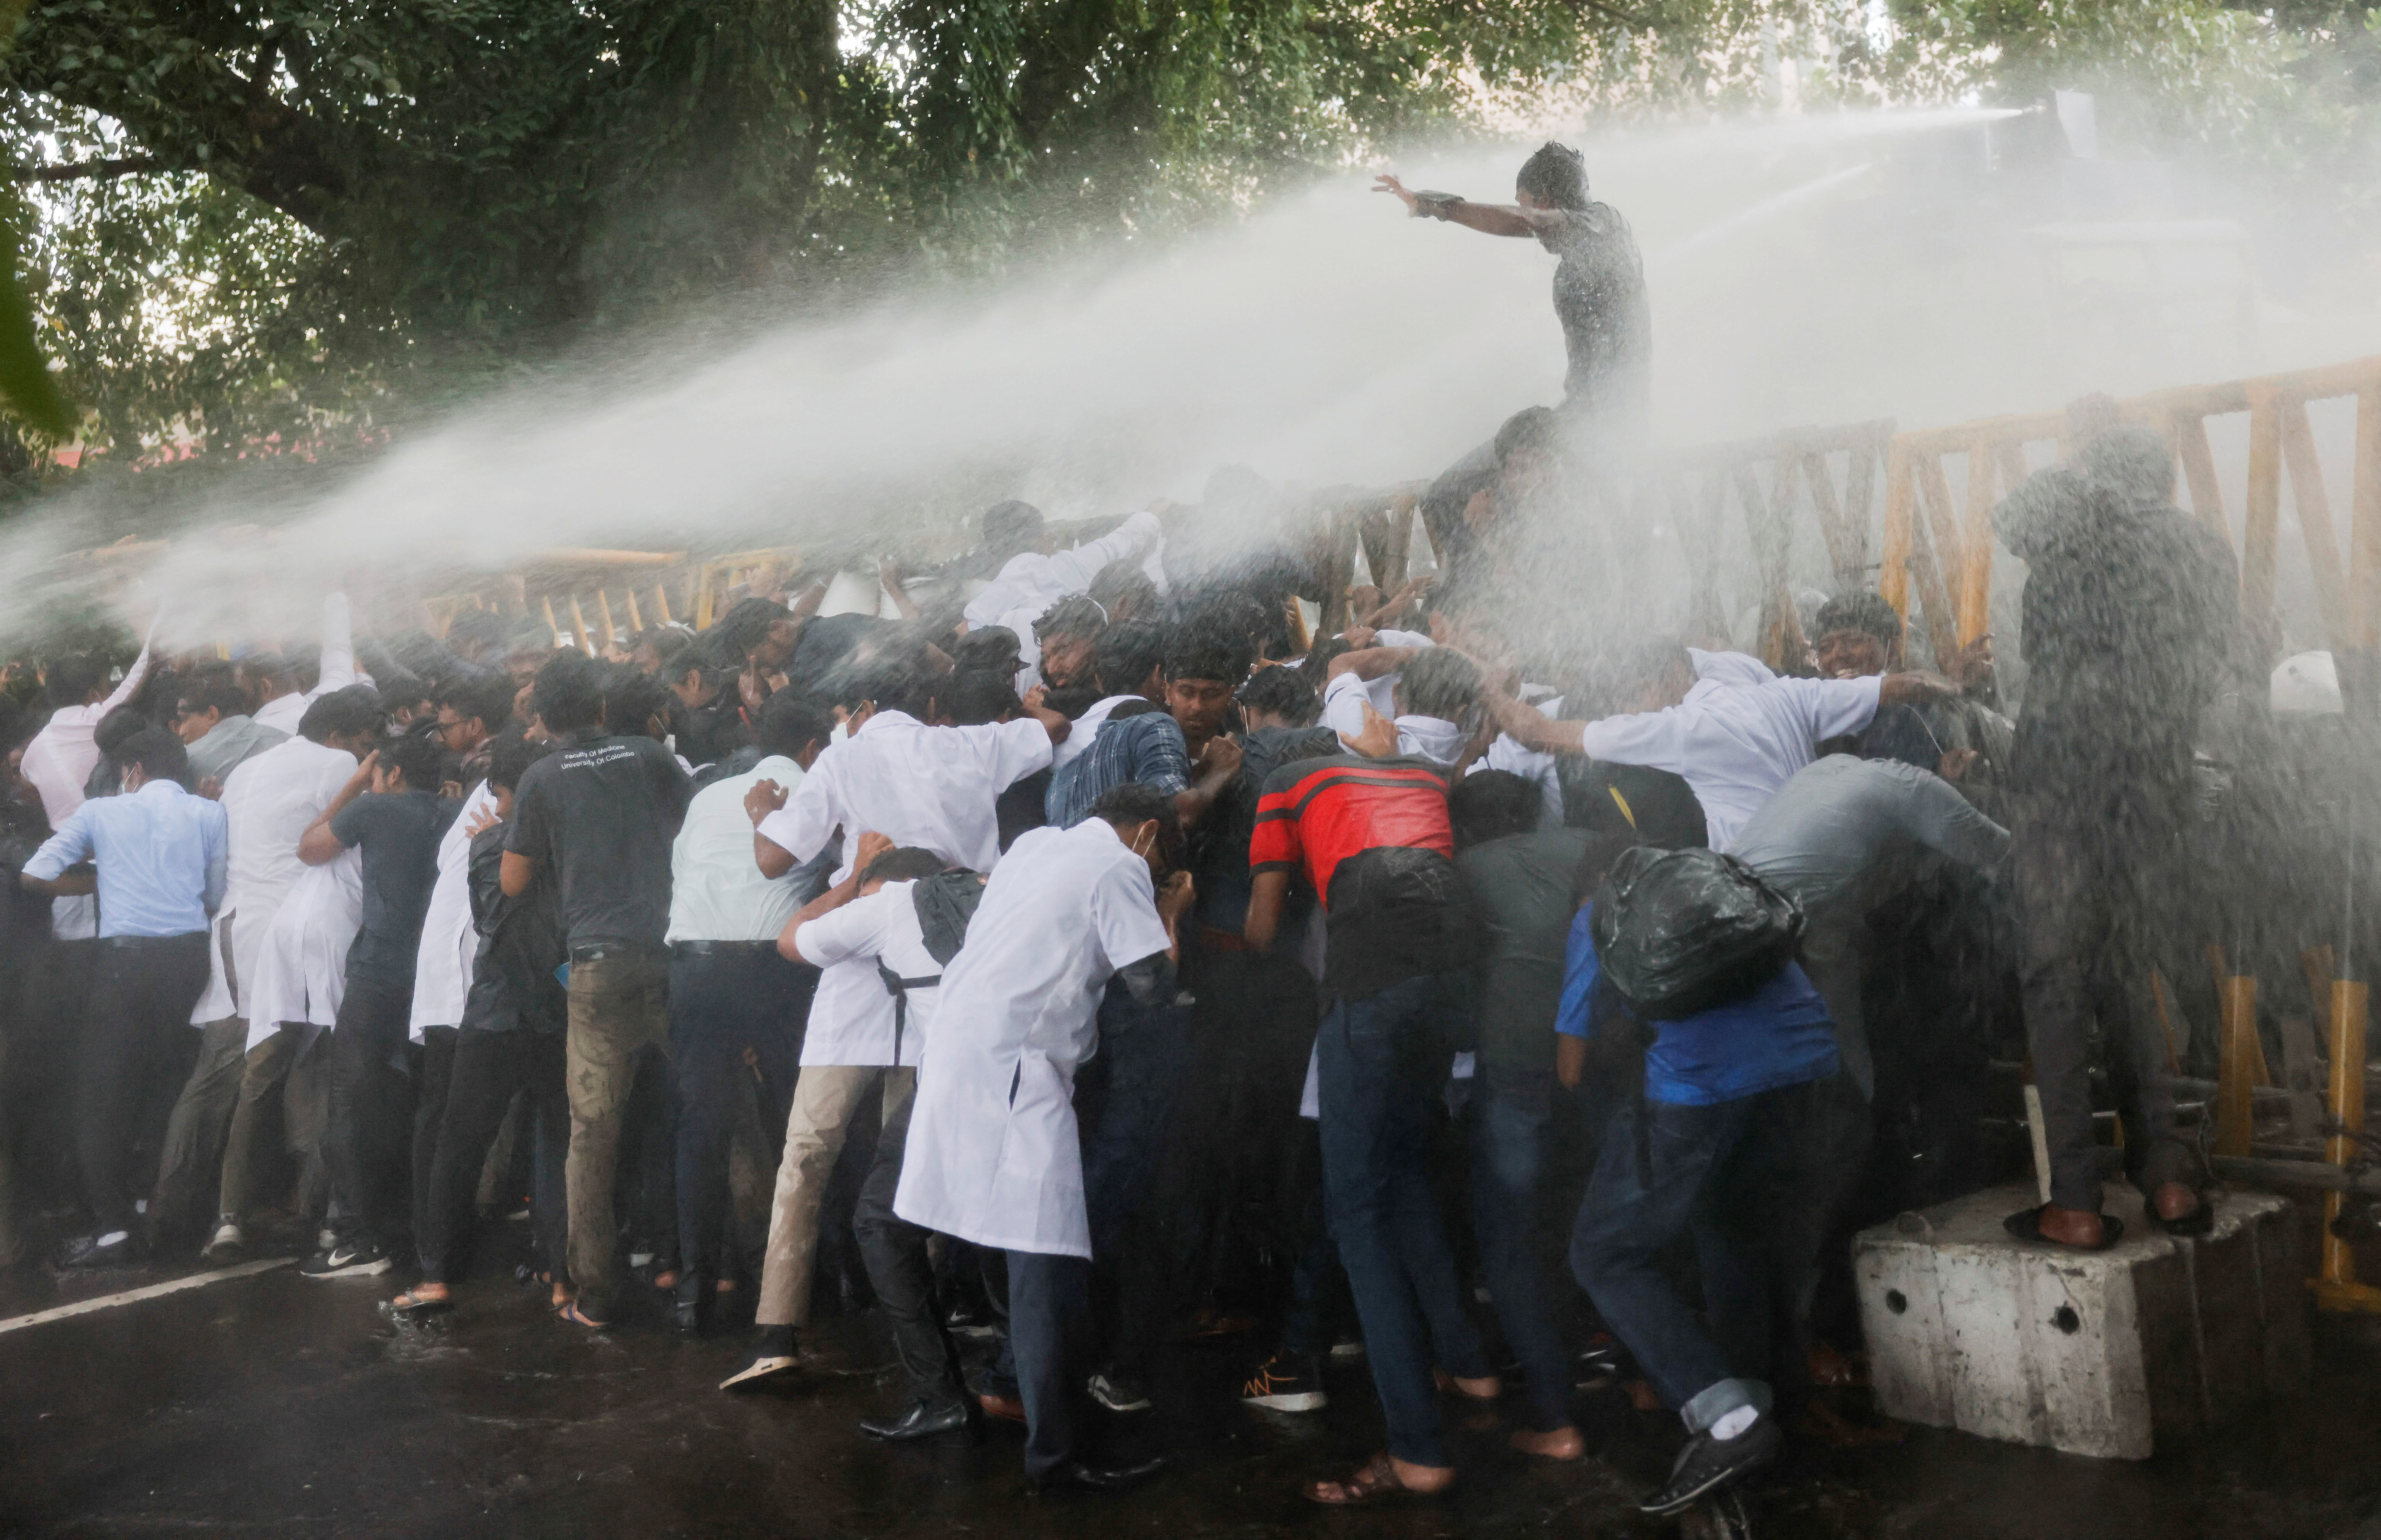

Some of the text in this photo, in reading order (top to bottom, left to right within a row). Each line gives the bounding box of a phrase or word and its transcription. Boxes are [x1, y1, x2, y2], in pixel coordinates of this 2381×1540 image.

[597, 745, 625, 754] Medicine
[561, 759, 594, 770] University
[606, 751, 635, 761] Colombo
